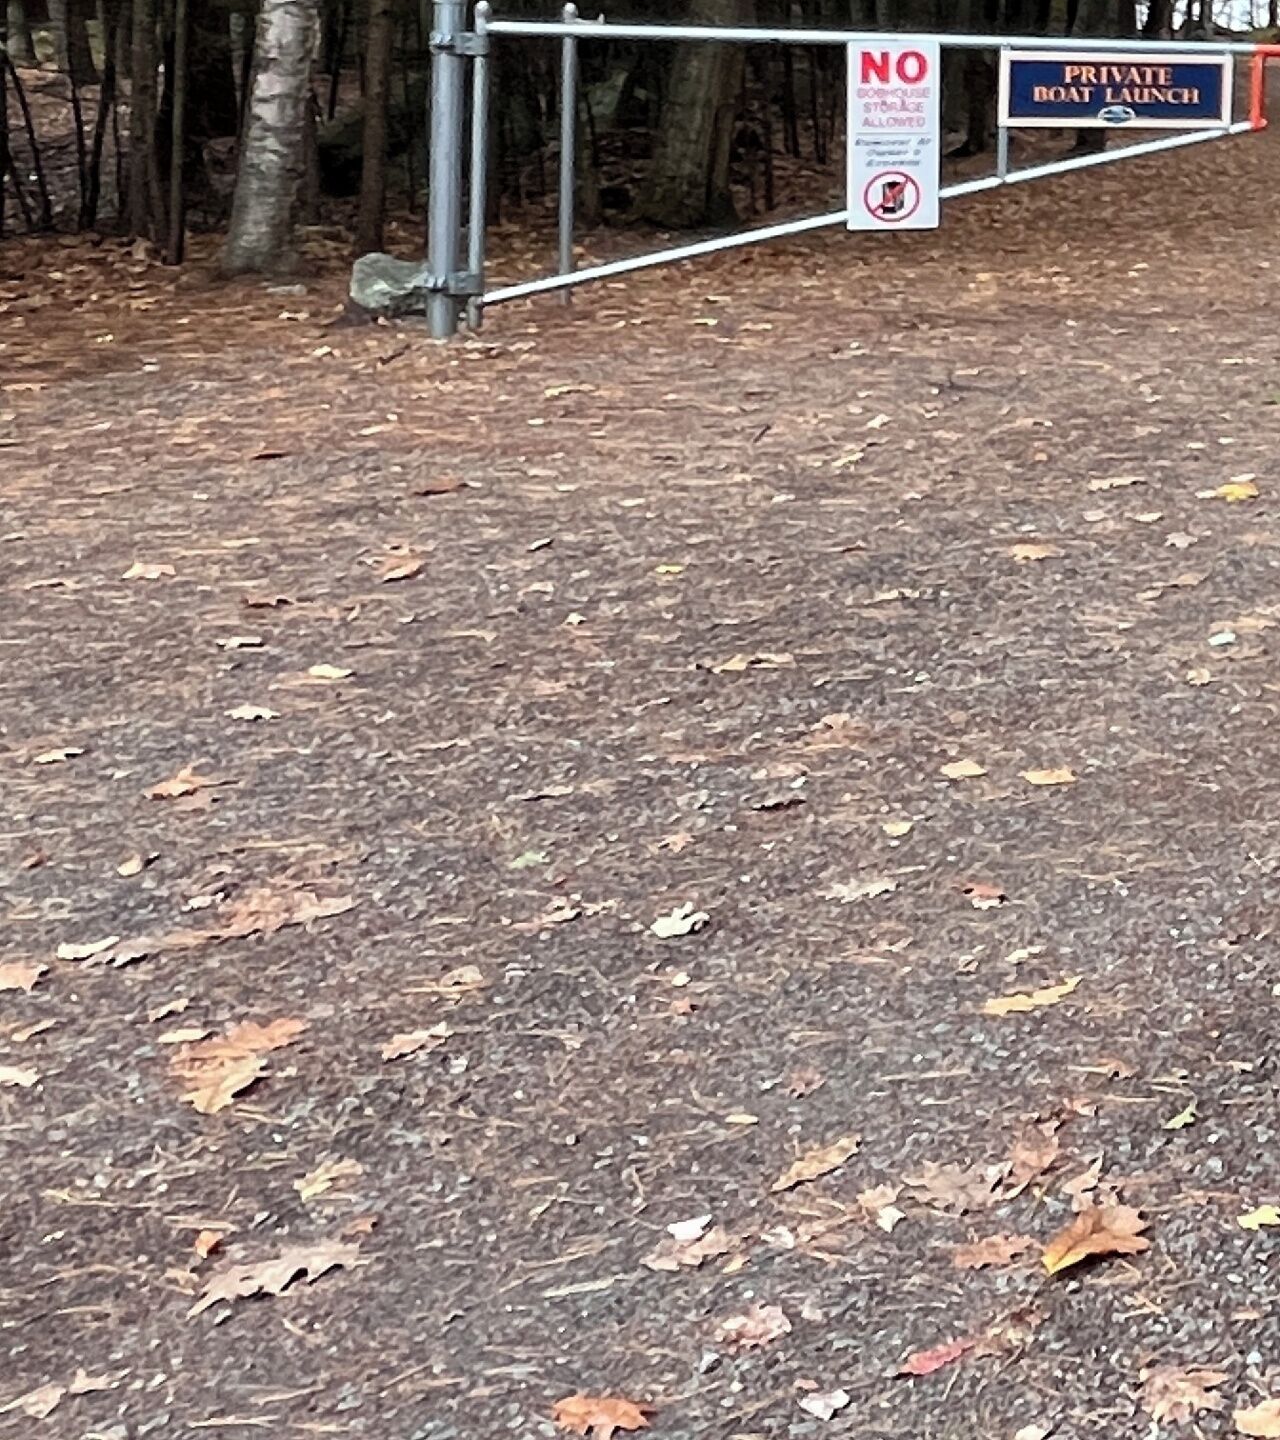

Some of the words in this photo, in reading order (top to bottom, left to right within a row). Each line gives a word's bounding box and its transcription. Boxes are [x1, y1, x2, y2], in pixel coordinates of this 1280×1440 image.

[861, 51, 928, 84] NO
[1064, 65, 1173, 86] PRIVATE
[1033, 86, 1095, 103] BOAT
[1105, 87, 1200, 105] LAUNCH
[863, 101, 924, 113] STORAGE
[862, 117, 926, 128] ALLOWED
